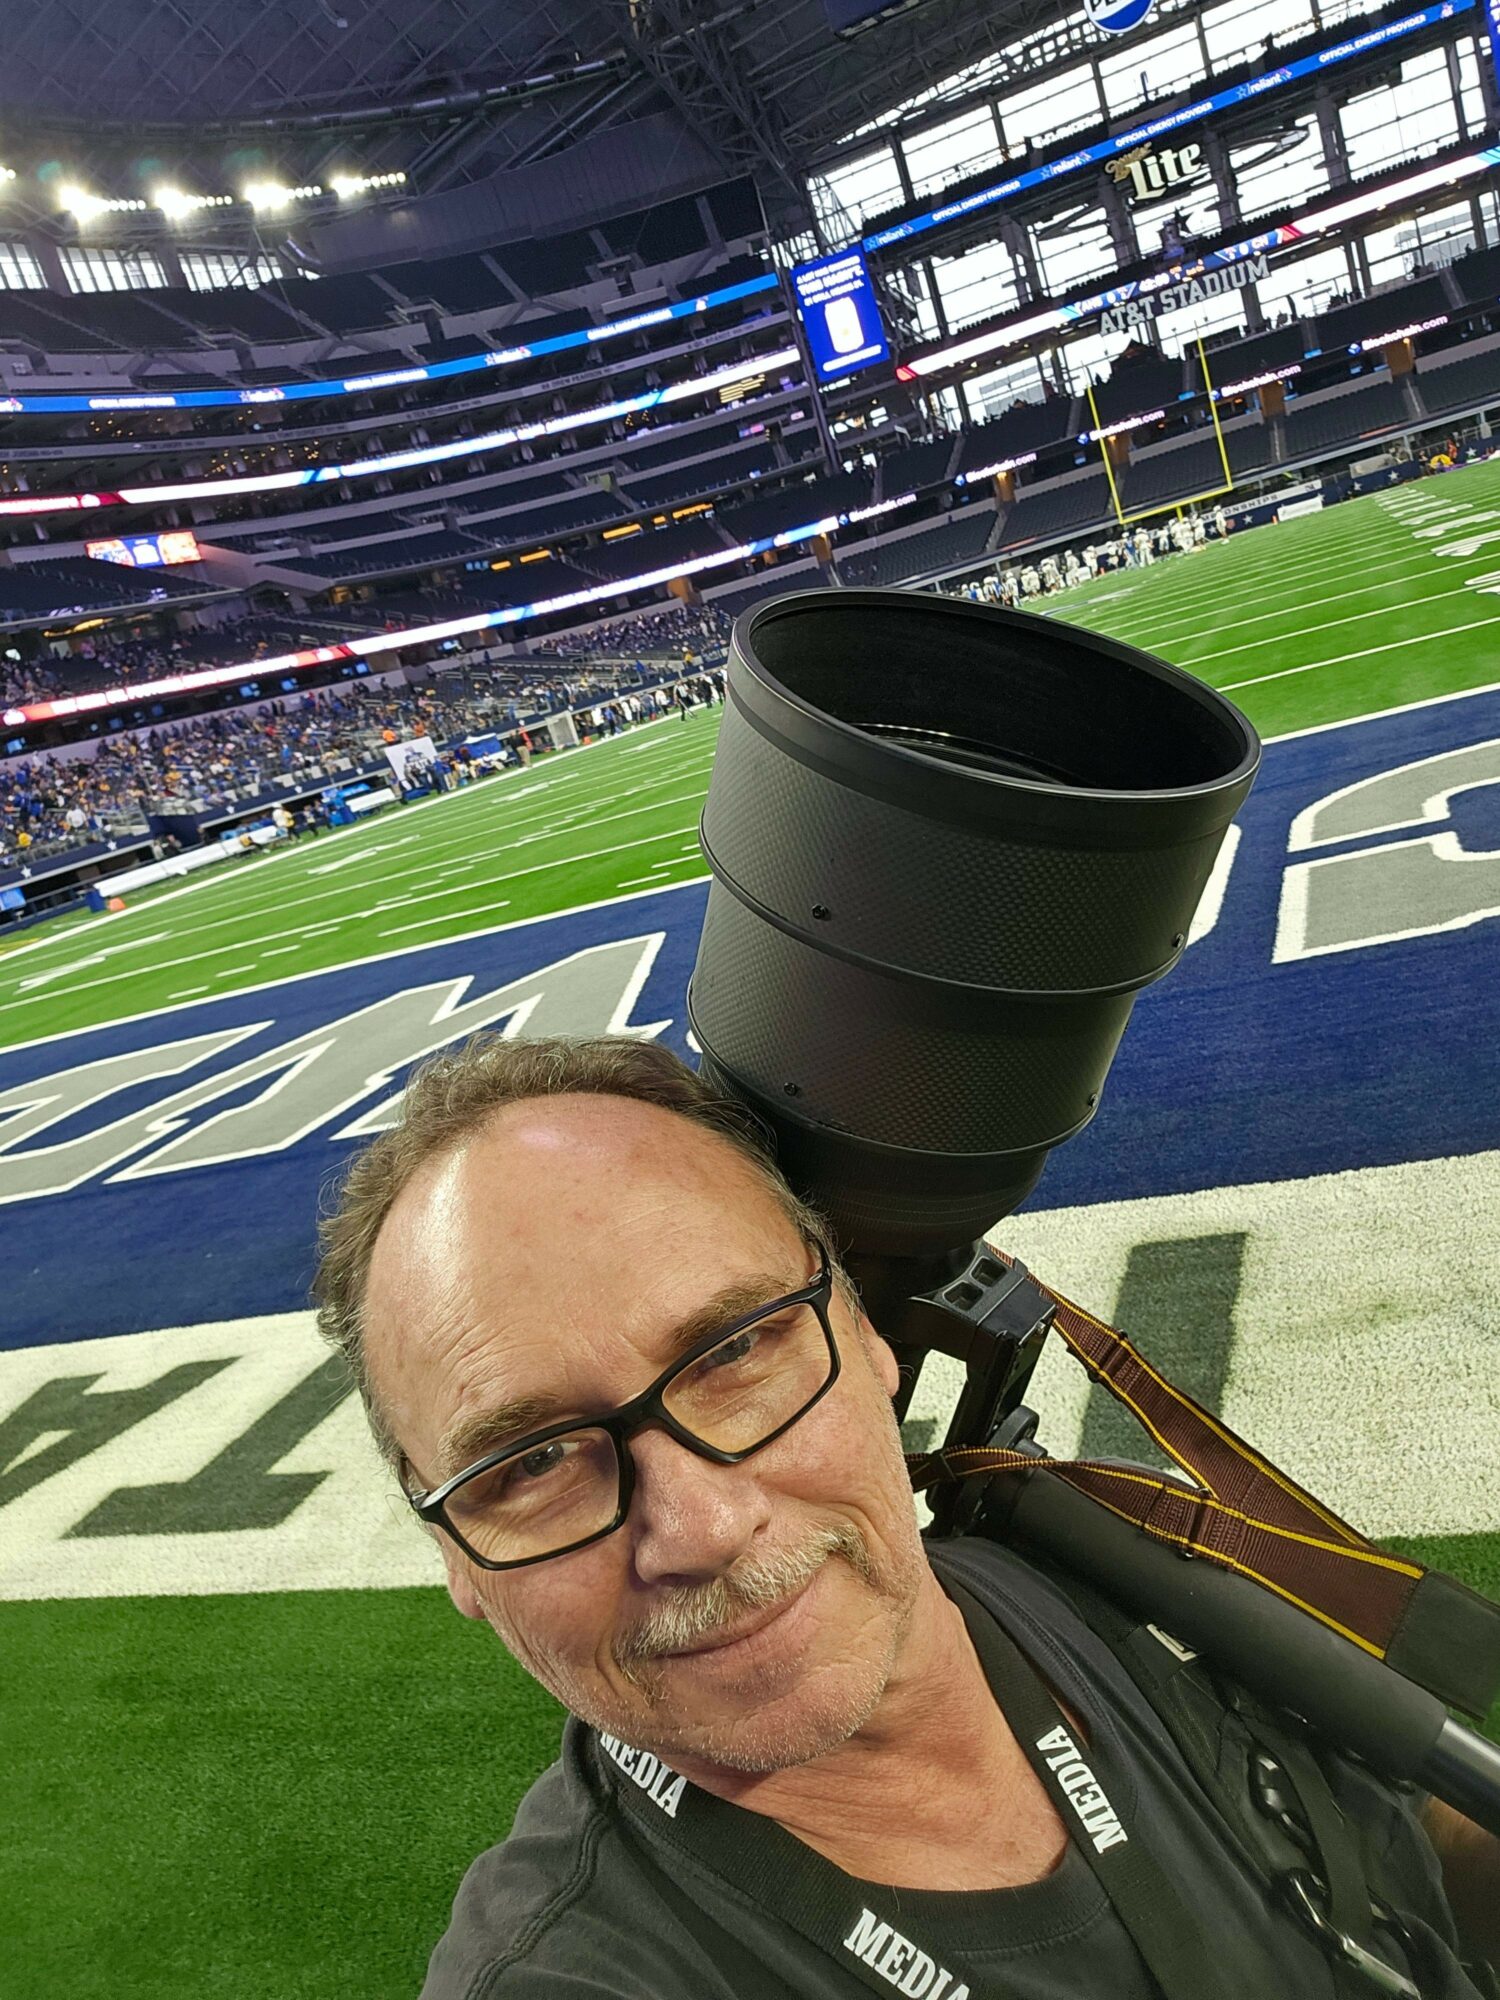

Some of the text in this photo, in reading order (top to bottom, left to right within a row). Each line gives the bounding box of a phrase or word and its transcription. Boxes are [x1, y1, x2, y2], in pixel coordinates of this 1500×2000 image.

[1319, 14, 1426, 62] OFFICIAL ENERGY PROVIDER
[1250, 72, 1282, 94] reliant
[1124, 144, 1201, 200] Lite
[1100, 296, 1155, 336] AT&T
[1160, 254, 1272, 314] STADIUM
[1361, 315, 1448, 351] Blockchain.com
[1036, 1725, 1128, 1854] MEDIA
